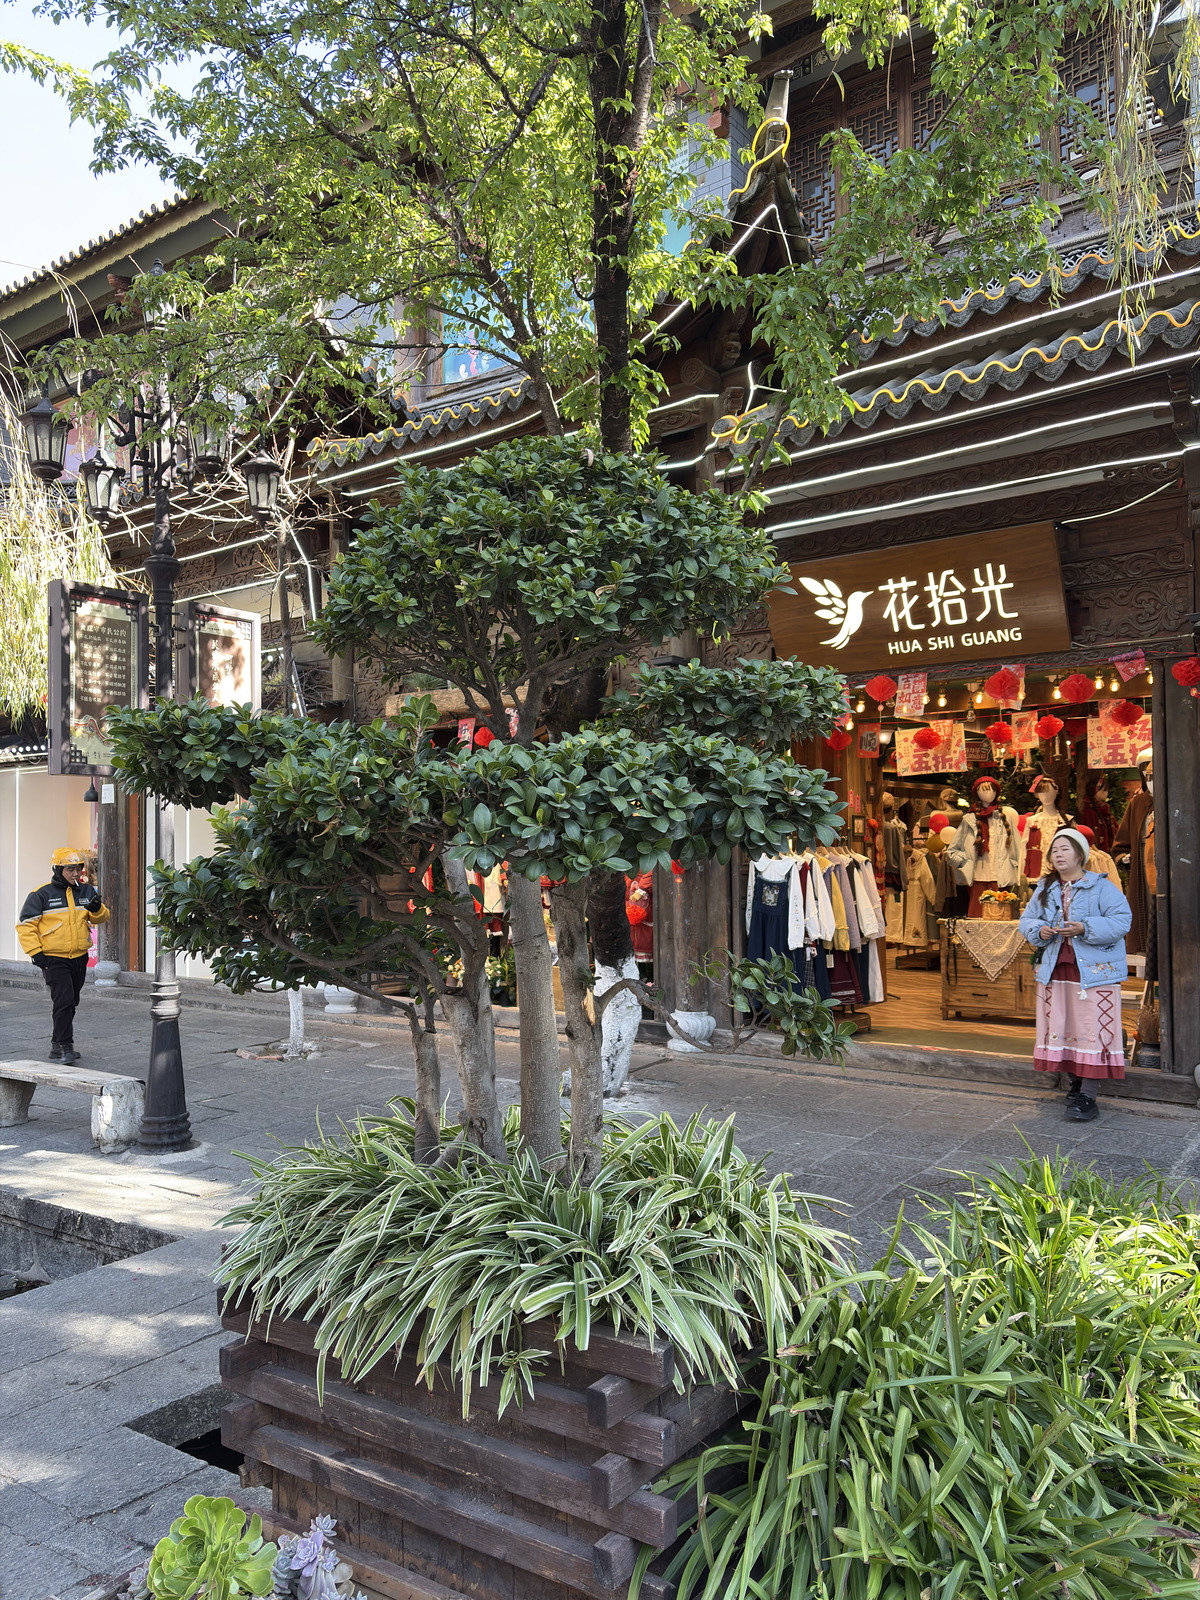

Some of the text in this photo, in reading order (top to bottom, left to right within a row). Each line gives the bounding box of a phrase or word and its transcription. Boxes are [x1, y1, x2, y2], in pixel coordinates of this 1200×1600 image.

[878, 563, 1019, 633] 花拾光
[888, 627, 1022, 655] HUA SHI GUANG
